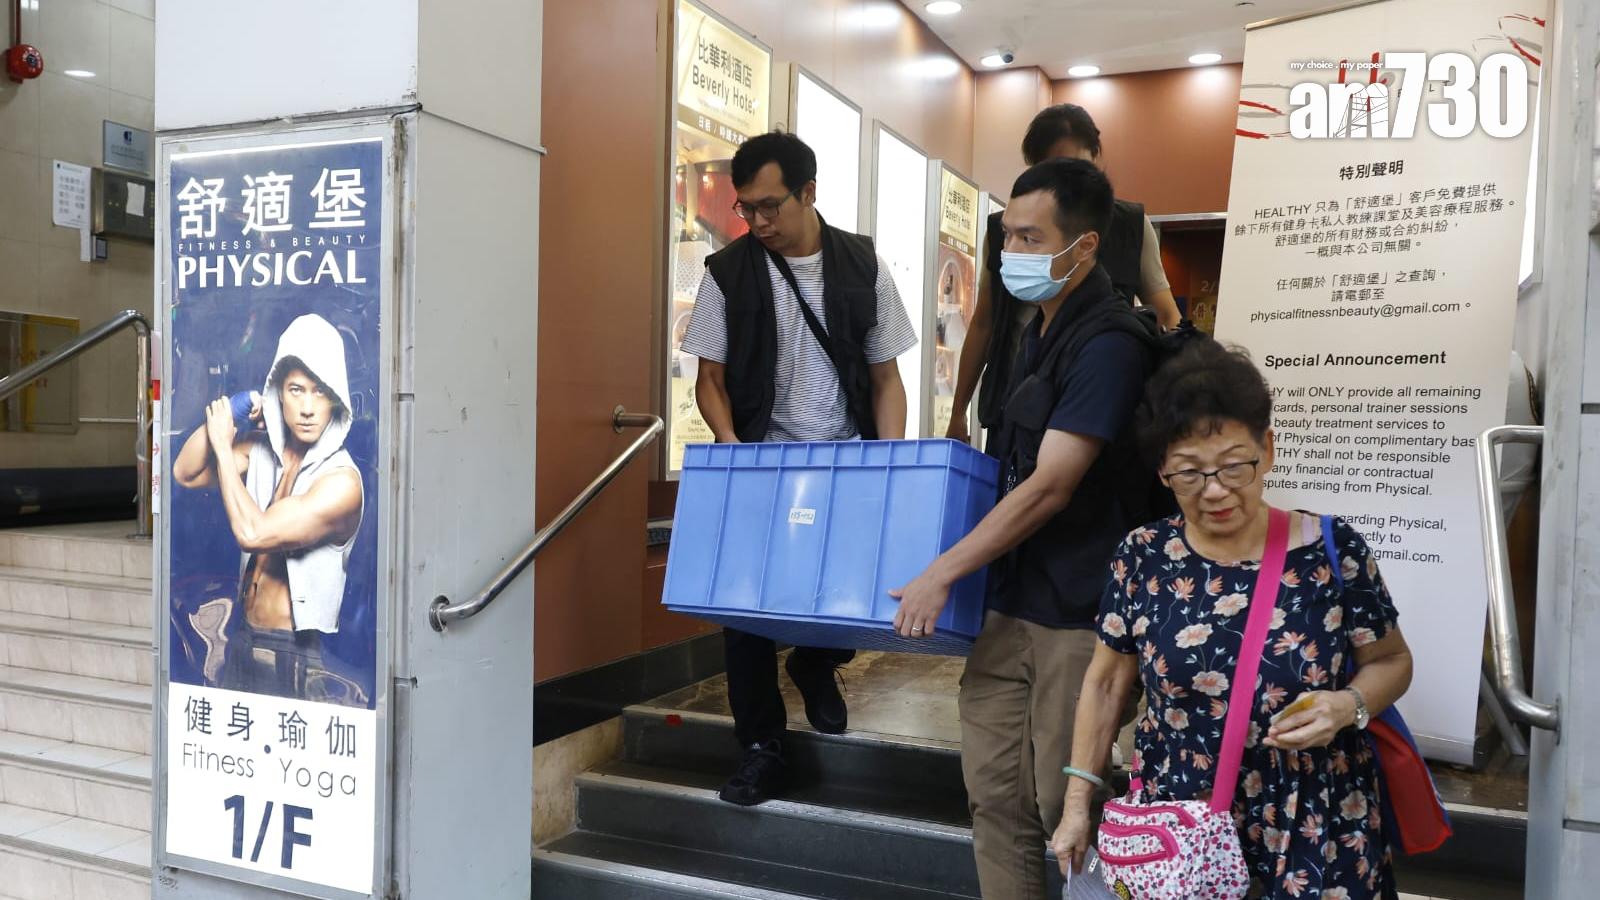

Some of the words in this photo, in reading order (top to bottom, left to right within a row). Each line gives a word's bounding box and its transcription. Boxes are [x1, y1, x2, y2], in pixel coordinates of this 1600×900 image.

[698, 36, 752, 88] 比華利酒店
[692, 64, 730, 106] Beverly
[1339, 160, 1403, 180] 特別聲明
[176, 168, 367, 240] 舒適堡
[1254, 203, 1312, 220] HEALTHY
[178, 240, 252, 252] FITNESS
[292, 235, 366, 246] BEAUTY
[178, 250, 366, 289] PHYSICAL
[1331, 288, 1385, 302] 請電郵至
[1265, 354, 1320, 370] Special
[1324, 351, 1446, 366] Announcement
[1288, 387, 1305, 397] will
[1309, 386, 1344, 397] ONLY
[1348, 386, 1393, 400] provide
[1397, 386, 1412, 397] all
[1415, 386, 1481, 400] remaining
[1274, 403, 1307, 414] cards,
[1311, 402, 1363, 414] personal
[1367, 403, 1406, 413] trainer
[1410, 402, 1468, 413] sessions
[1274, 418, 1312, 430] beauty
[1316, 419, 1373, 429] treatment
[1376, 419, 1428, 429] services
[1433, 419, 1445, 430] to
[1284, 432, 1332, 445] Physical
[1336, 436, 1350, 444] on
[1354, 434, 1447, 449] complimentary
[1452, 436, 1475, 447] bas
[1276, 447, 1301, 458] THY
[1304, 448, 1331, 459] shall
[1334, 450, 1353, 460] not
[1357, 450, 1372, 461] be
[1376, 452, 1451, 464] responsible
[1272, 465, 1292, 476] any
[1296, 464, 1344, 476] financial
[1348, 468, 1360, 476] or
[1364, 467, 1434, 479] contractual
[1264, 479, 1298, 490] sputes
[1301, 480, 1340, 494] arising
[1344, 480, 1372, 492] from
[1376, 482, 1432, 496] Physical.
[1389, 515, 1447, 532] Physical,
[1390, 533, 1402, 543] to
[1370, 548, 1444, 563] gmail.com.
[184, 695, 254, 742] 健身
[278, 710, 356, 758] 瑜伽
[182, 742, 254, 778] Fitness
[280, 758, 356, 798] Yoga
[224, 794, 313, 870] 1/F
